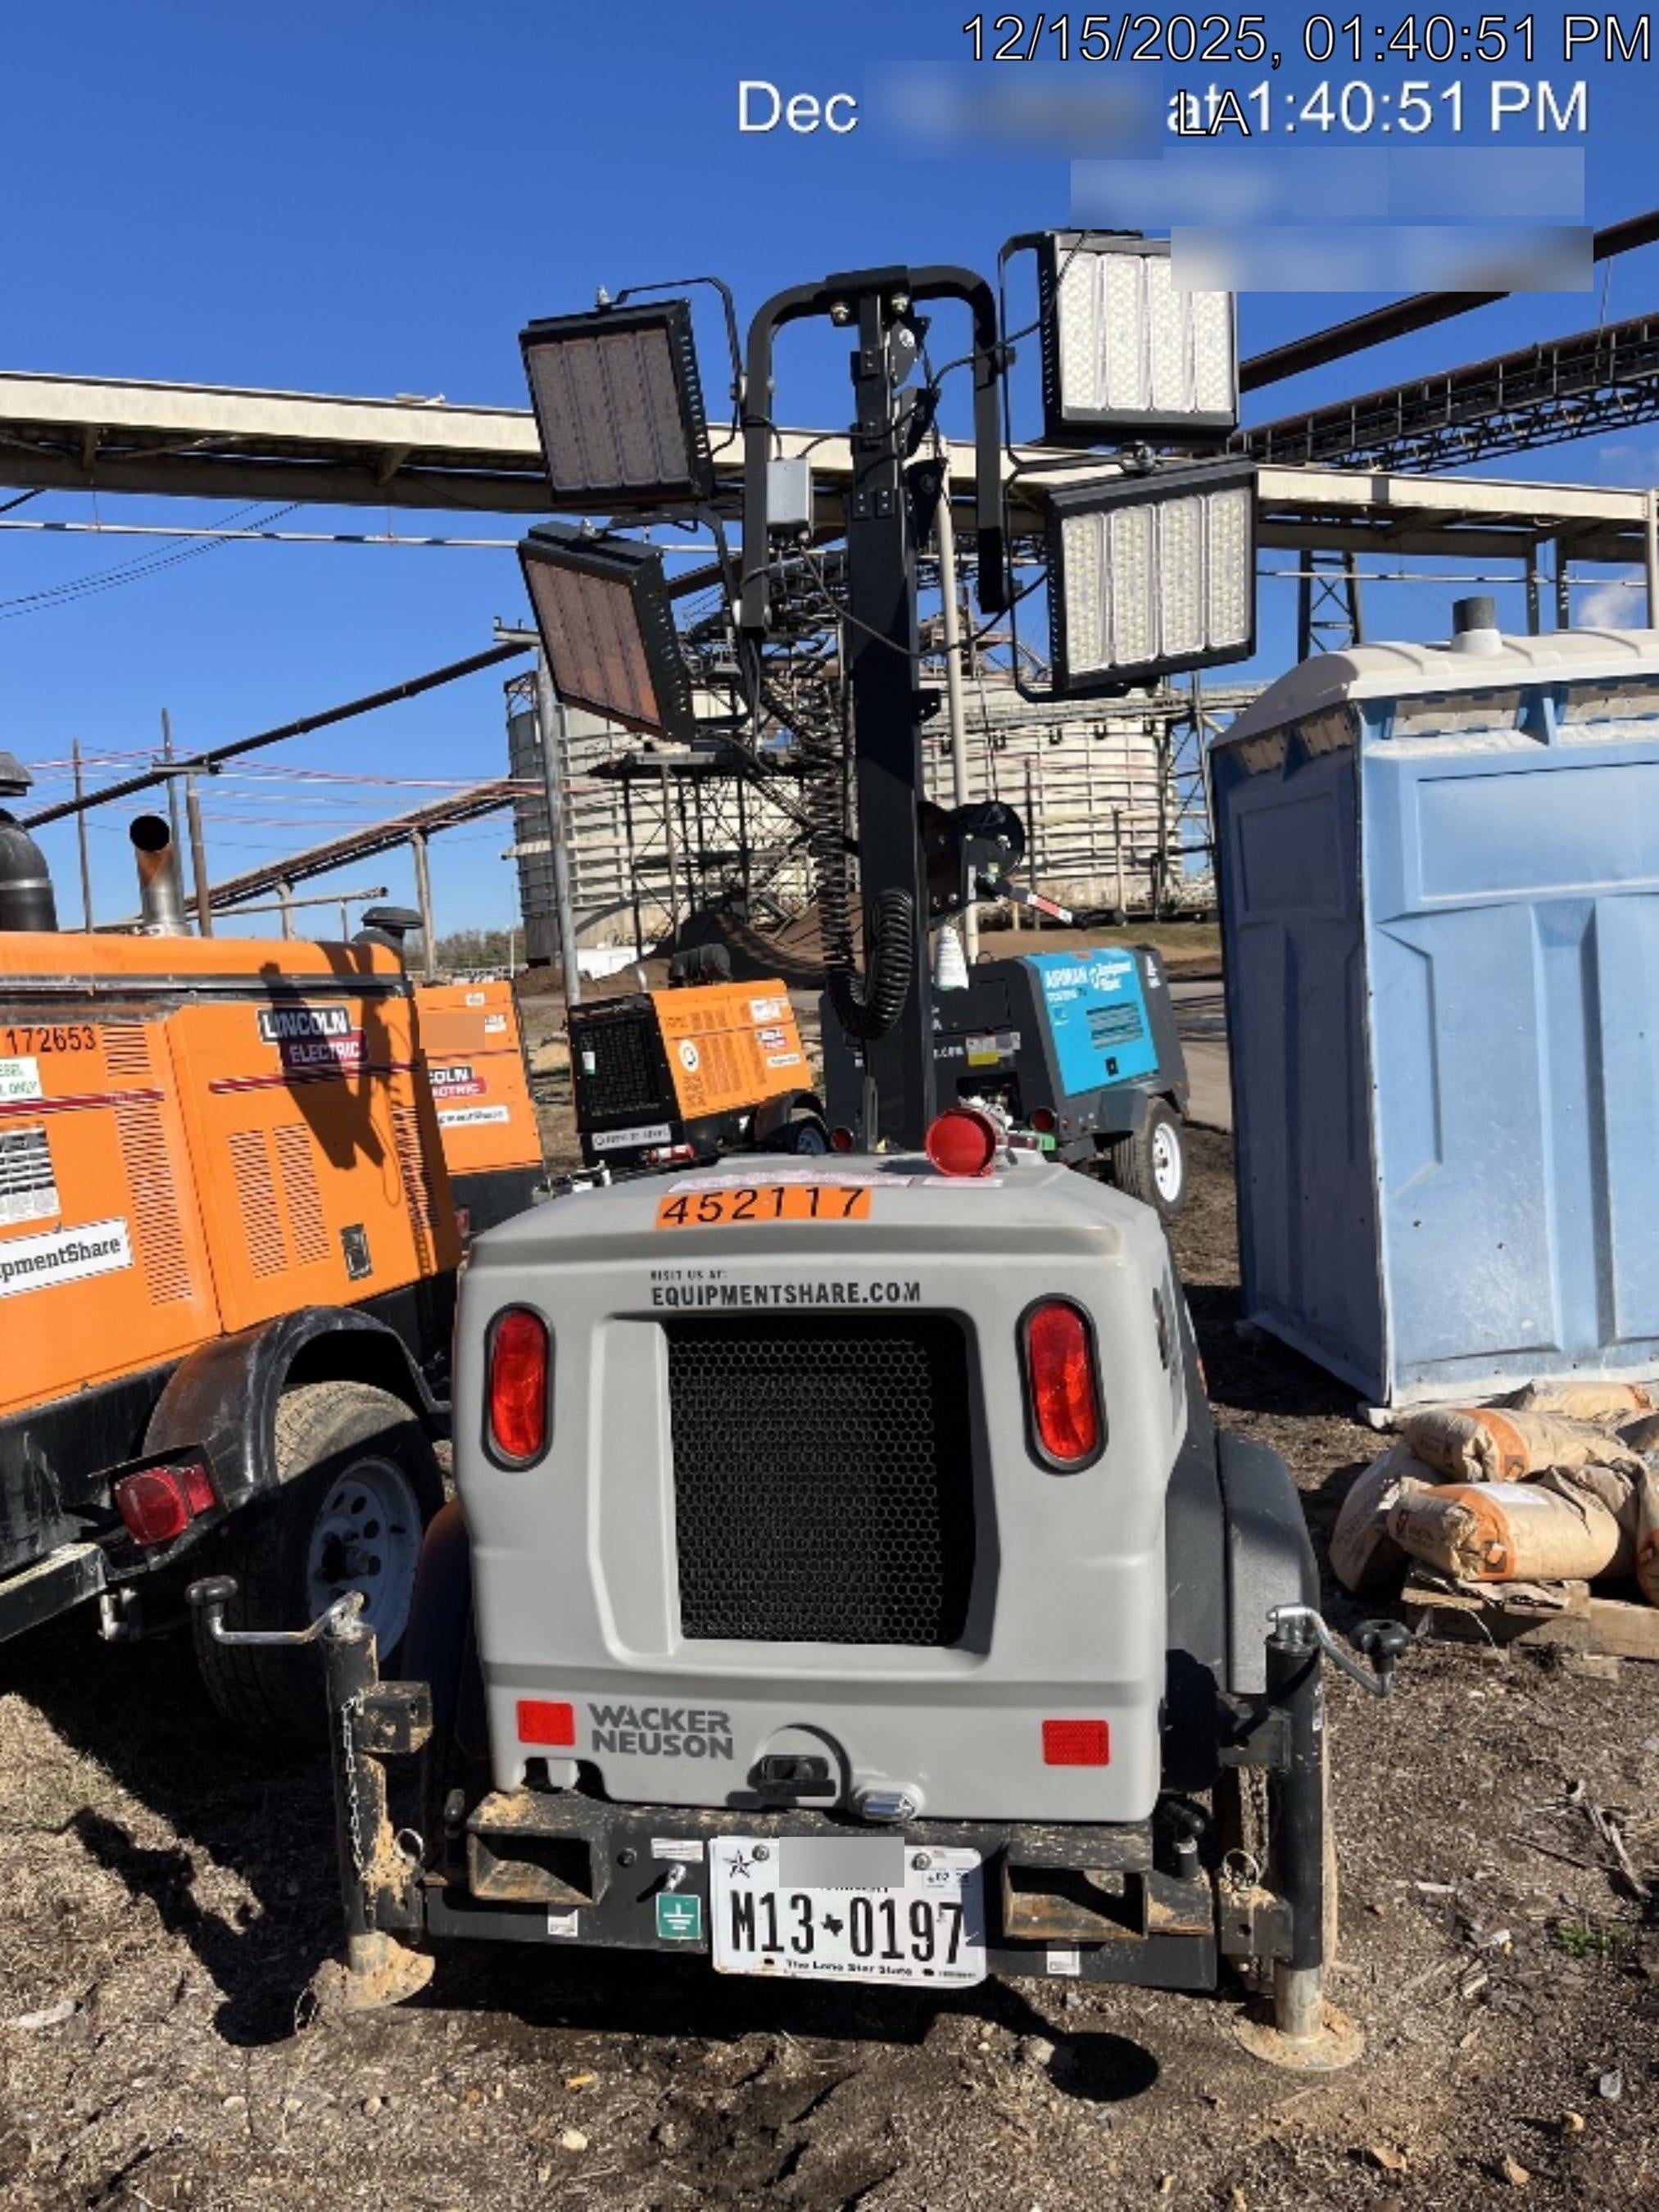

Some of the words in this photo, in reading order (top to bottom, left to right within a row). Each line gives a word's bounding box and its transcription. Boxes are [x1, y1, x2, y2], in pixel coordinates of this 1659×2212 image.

[261, 1009, 348, 1039] LINCOLN
[6, 1026, 97, 1055] 172653
[288, 1041, 361, 1063] ELECTRIC
[662, 1186, 864, 1225] 452117
[652, 1281, 921, 1308] EQUIPMENTSHARE.COM
[587, 1702, 732, 1734] WACKER
[591, 1729, 734, 1761] NEUSON
[849, 1897, 964, 1965] 0197
